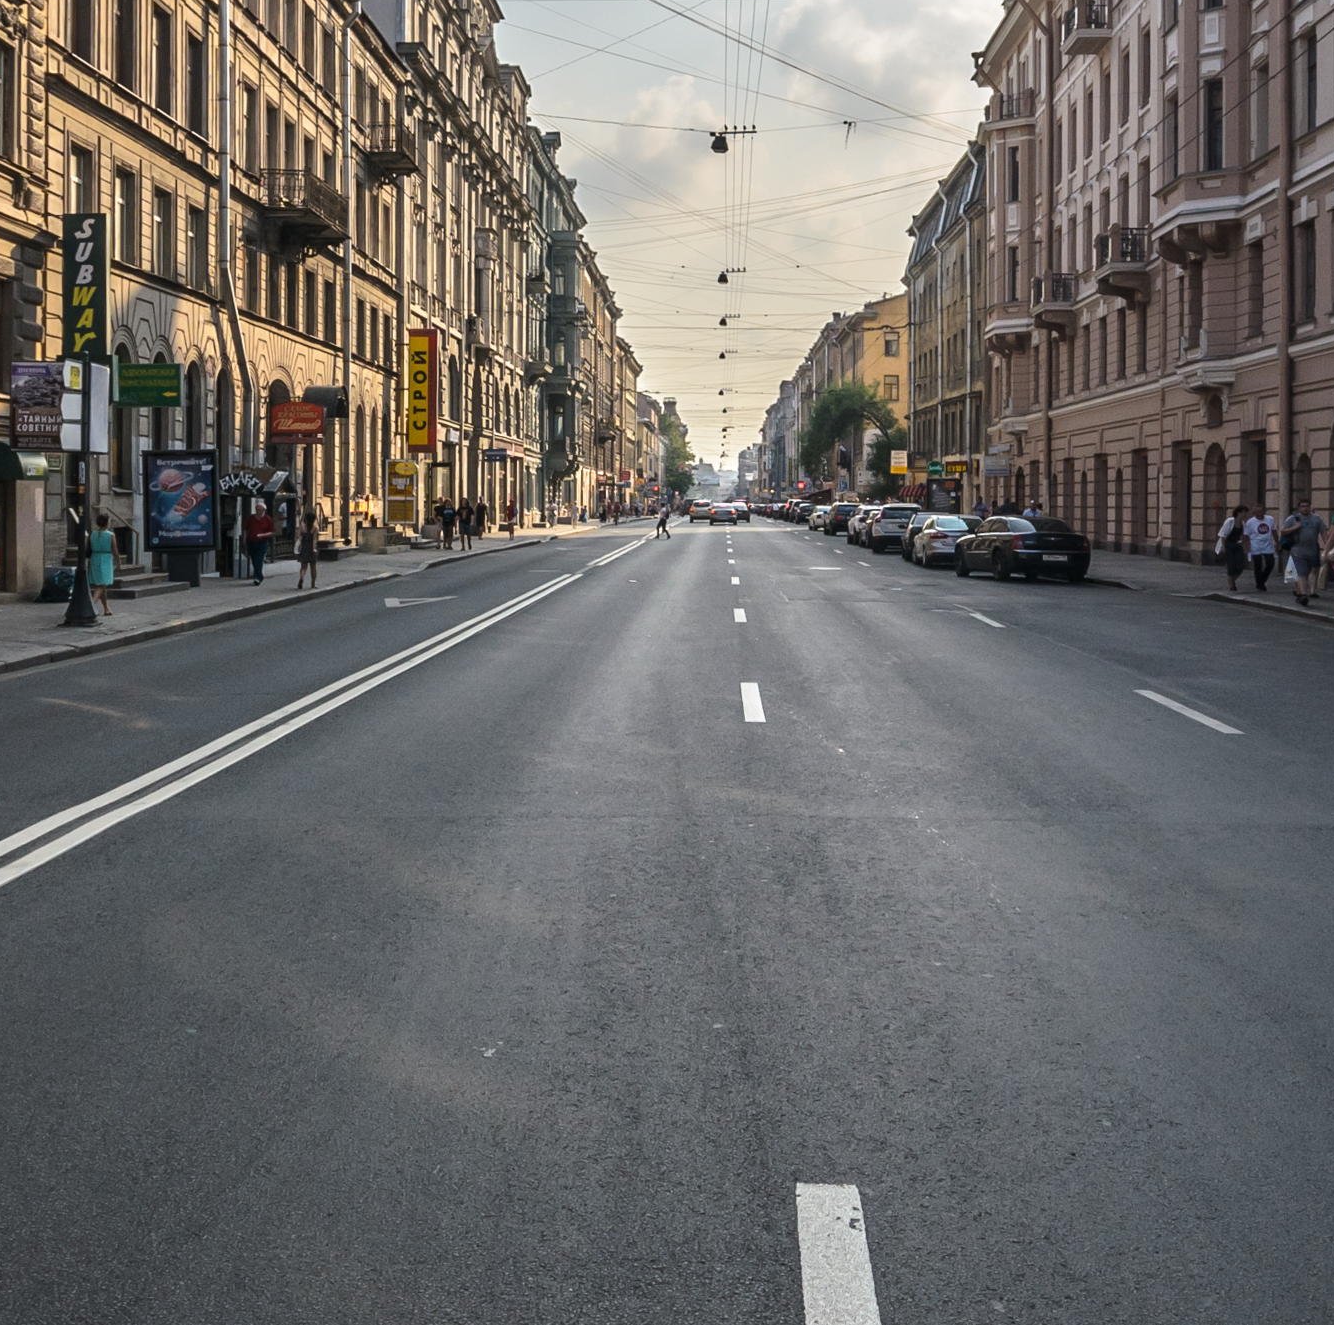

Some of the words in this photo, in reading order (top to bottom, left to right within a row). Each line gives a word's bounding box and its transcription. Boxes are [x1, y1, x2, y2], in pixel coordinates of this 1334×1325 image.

[72, 218, 97, 353] SUBWAY
[17, 424, 62, 432] СОВЕТНИ
[411, 350, 428, 431] СТРОЙ
